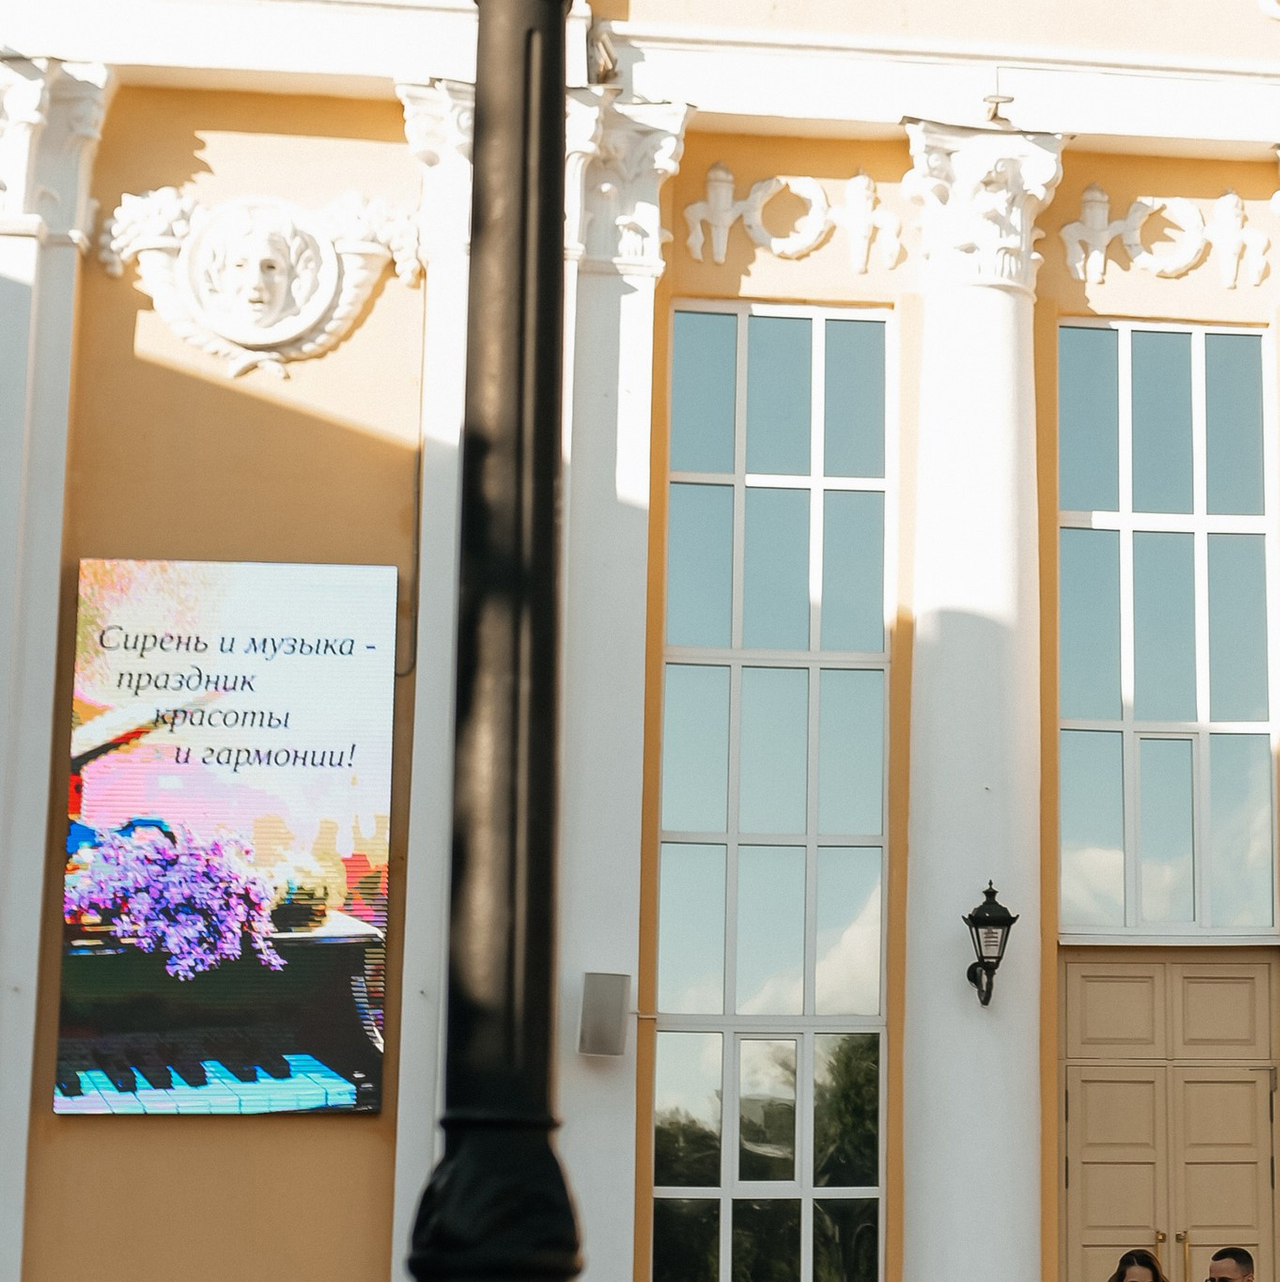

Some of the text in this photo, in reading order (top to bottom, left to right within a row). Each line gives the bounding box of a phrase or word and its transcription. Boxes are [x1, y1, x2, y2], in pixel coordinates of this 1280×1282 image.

[100, 625, 208, 658] Сирень
[219, 636, 236, 654] и
[244, 636, 355, 661] музыка
[116, 665, 256, 697] праздник
[154, 708, 290, 733] красоты
[174, 743, 356, 773] и гармонии!
